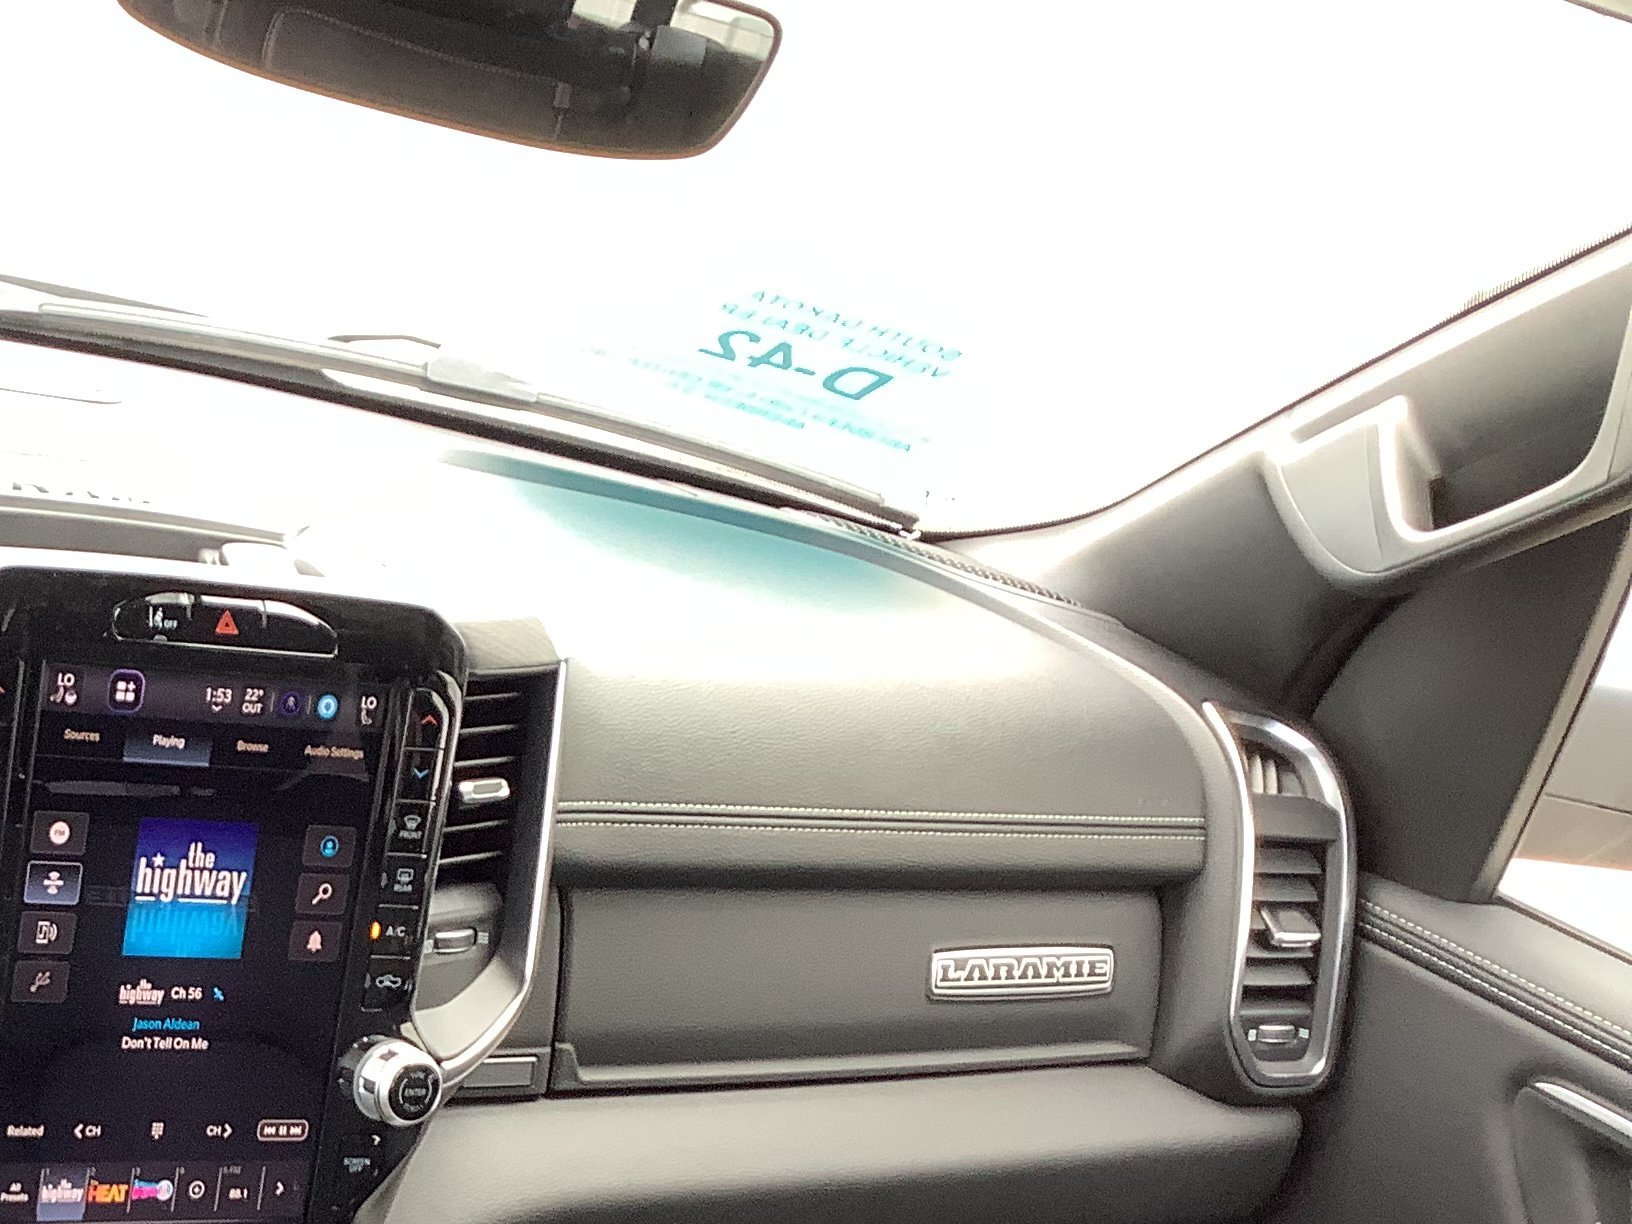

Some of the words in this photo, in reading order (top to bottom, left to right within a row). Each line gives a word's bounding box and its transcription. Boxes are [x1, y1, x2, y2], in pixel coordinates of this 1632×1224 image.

[57, 672, 76, 687] LO
[205, 687, 233, 703] 1:53
[360, 695, 378, 710] LO
[241, 702, 264, 715] OUT
[63, 728, 101, 743] Sources
[152, 733, 186, 750] Playing
[187, 841, 216, 868] the
[135, 854, 248, 906] highway
[939, 955, 1109, 984] LARAMIE
[119, 983, 165, 1007] highway
[170, 986, 187, 1000] Ch
[187, 987, 203, 1000] 56
[131, 1017, 162, 1032] Jason
[162, 1017, 200, 1031] Aldean
[121, 1035, 152, 1050] Don't
[152, 1036, 172, 1050] Tell
[173, 1037, 190, 1050] On
[191, 1036, 209, 1050] Me
[7, 1124, 45, 1138] Related
[85, 1125, 102, 1137] CH
[87, 1183, 129, 1204] HEAT
